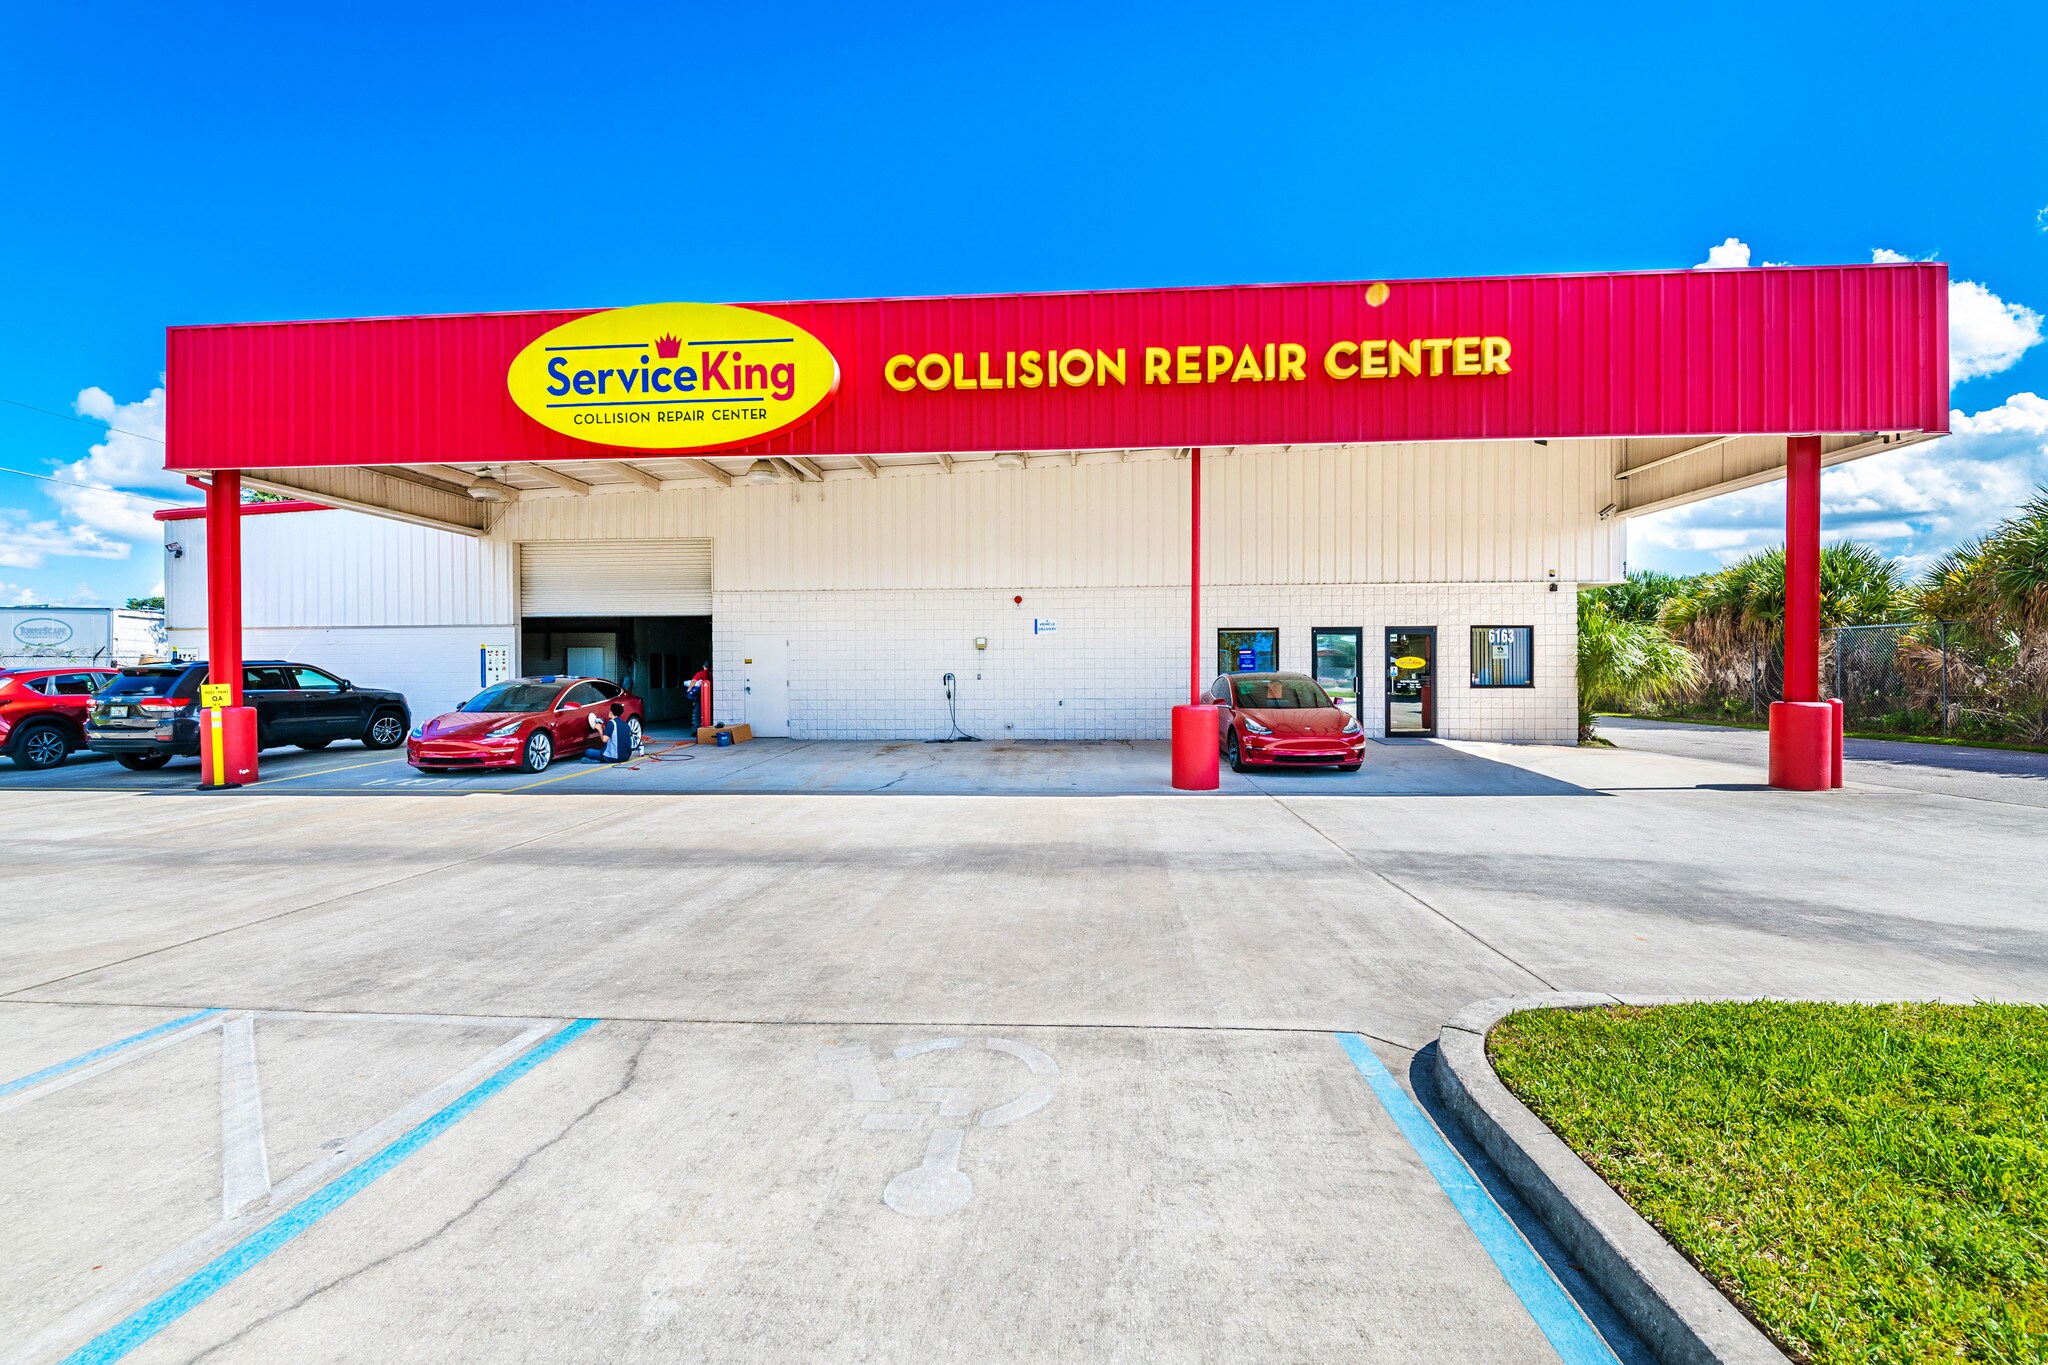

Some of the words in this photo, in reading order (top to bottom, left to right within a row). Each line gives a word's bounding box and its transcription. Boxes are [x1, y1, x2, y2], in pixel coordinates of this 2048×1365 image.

[884, 347, 1126, 391] COLLISION
[1145, 342, 1306, 385] REPAIR
[1323, 336, 1513, 380] CENTER
[573, 412, 650, 425] COLLISION
[658, 410, 704, 423] REPAIR
[712, 408, 767, 421] CENTER
[1489, 629, 1514, 643] 6163
